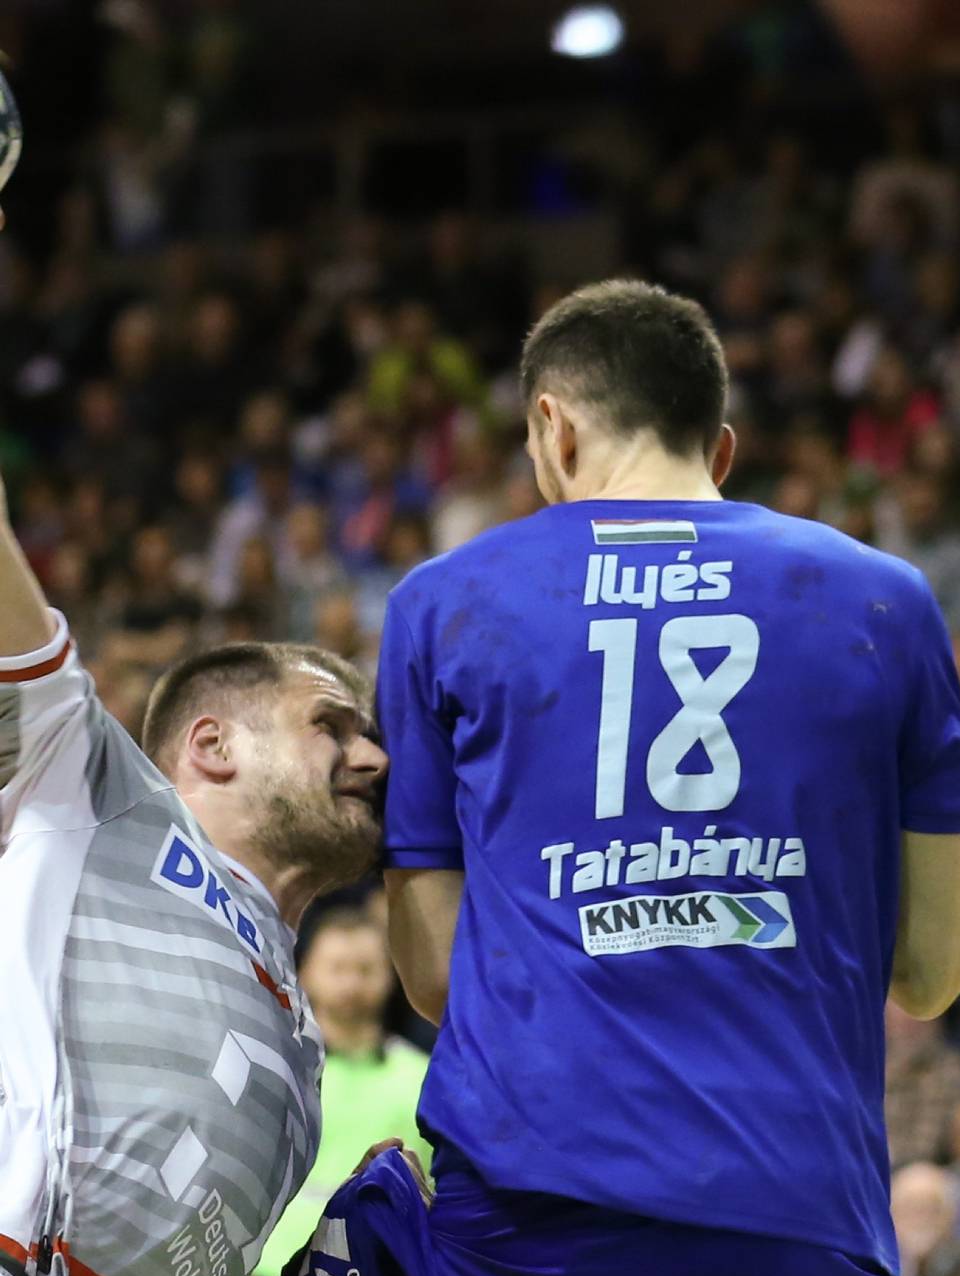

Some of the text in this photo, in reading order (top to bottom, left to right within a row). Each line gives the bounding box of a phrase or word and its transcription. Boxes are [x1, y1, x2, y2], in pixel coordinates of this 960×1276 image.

[582, 549, 734, 610] Ilyés
[586, 613, 761, 820] 18
[540, 824, 806, 899] Tatabánya
[585, 894, 717, 936] KNYKK
